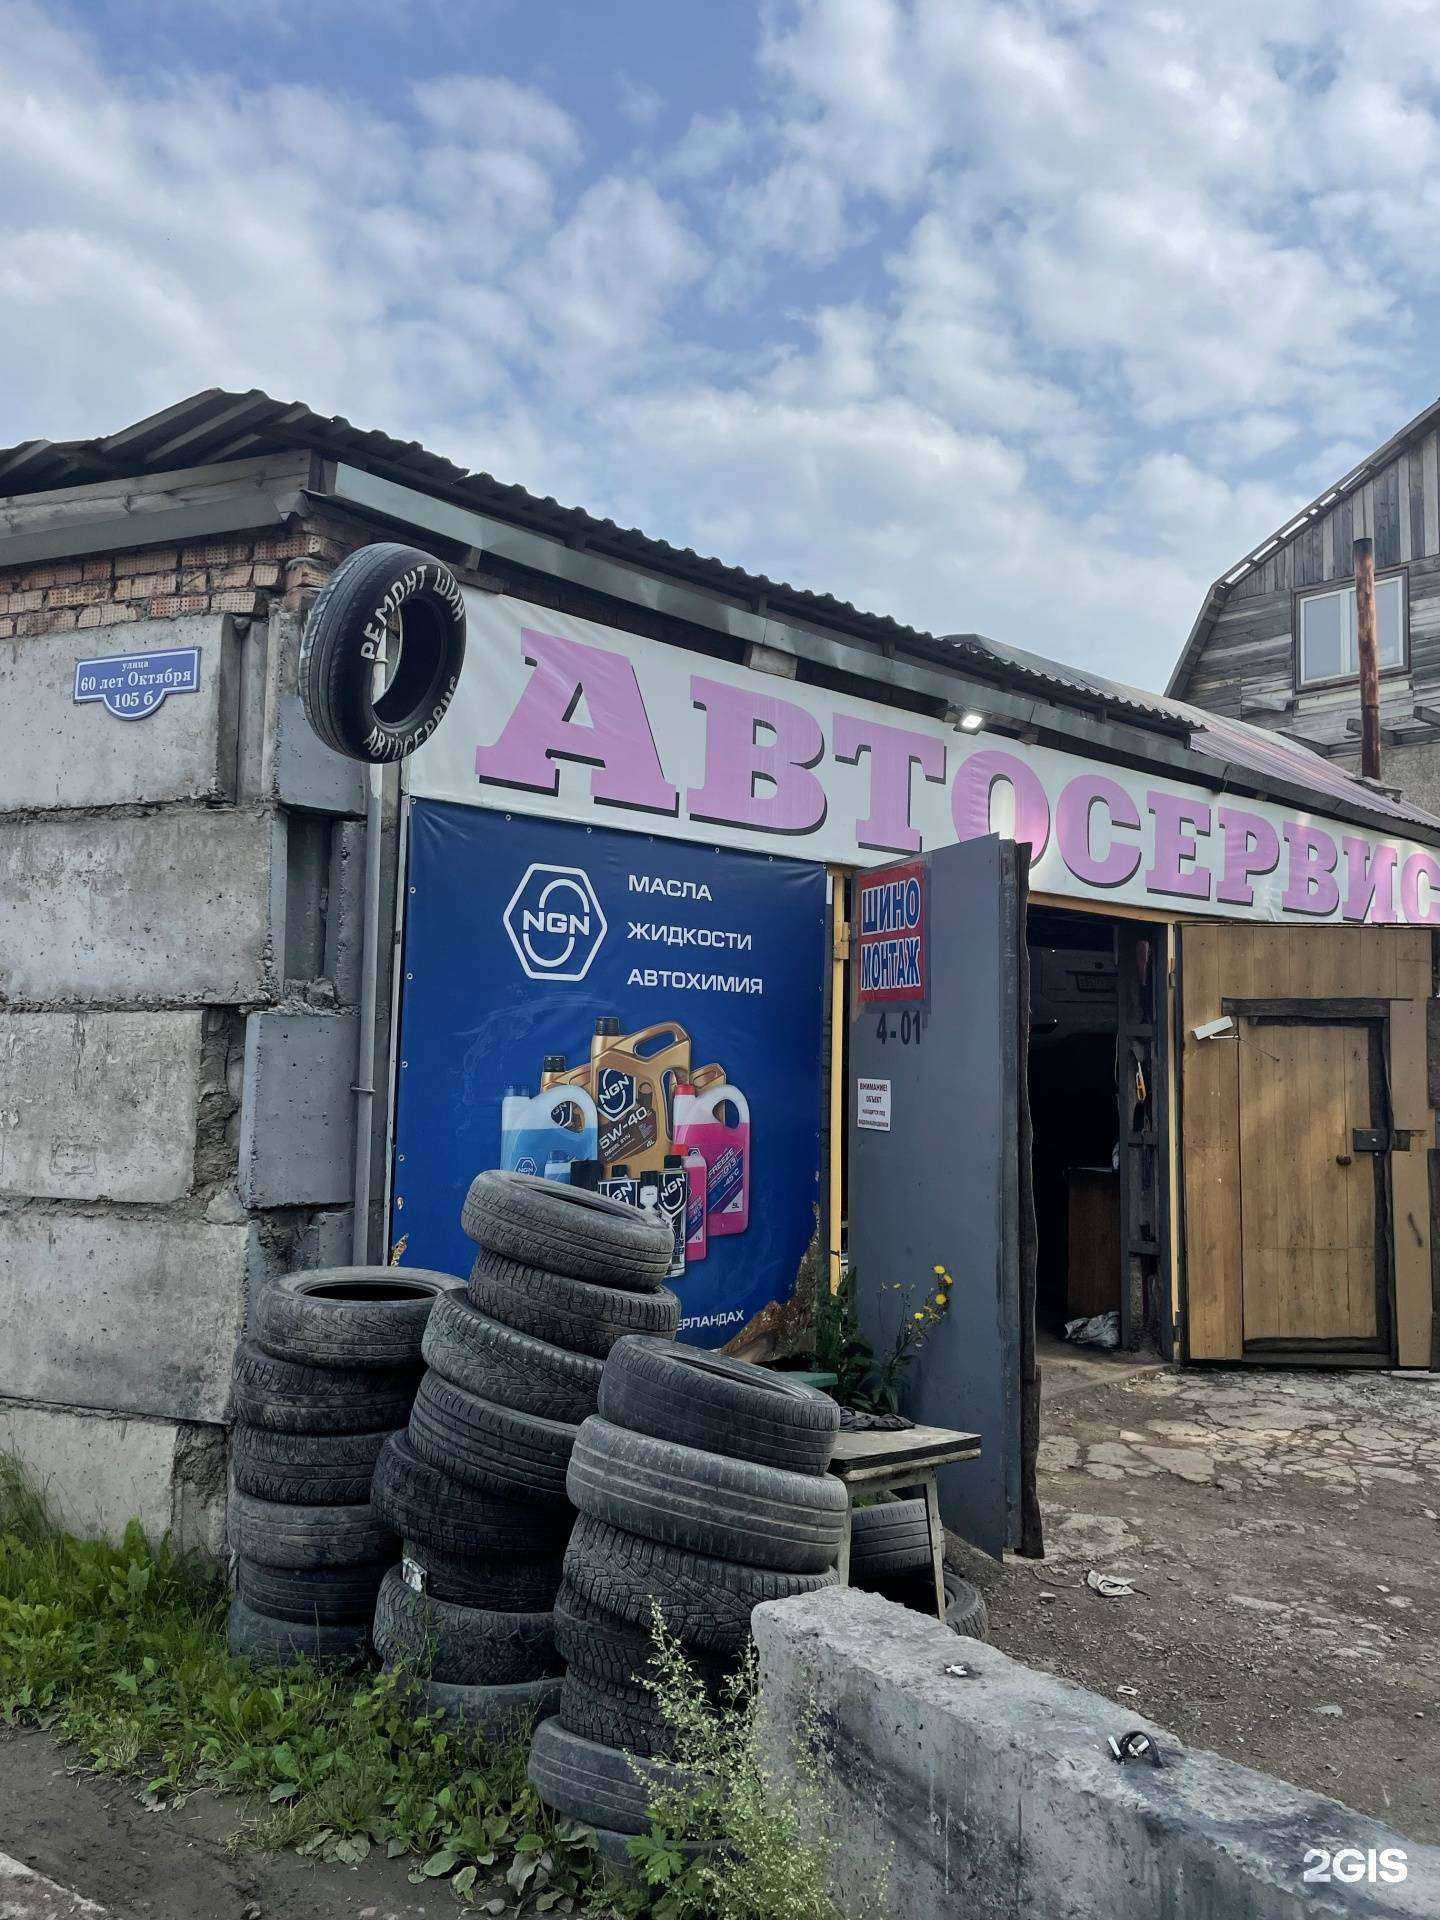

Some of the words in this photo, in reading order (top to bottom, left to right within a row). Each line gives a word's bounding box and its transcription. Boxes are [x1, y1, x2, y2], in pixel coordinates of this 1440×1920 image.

[361, 565, 427, 660] РЕМОНТ
[433, 568, 465, 622] ШИН
[81, 677, 96, 691] 60
[99, 677, 123, 689] лет
[127, 667, 192, 686] Октября
[121, 660, 149, 671] улица
[114, 691, 139, 707] 105
[363, 676, 457, 759] АВТОСЕРВИС
[475, 627, 1440, 925] АВТОСЕРВИС
[628, 874, 713, 902] МАСЛА
[861, 877, 921, 936] ШИНО
[523, 909, 590, 936] NGN
[627, 921, 752, 951] ЖИДКОСТИ
[861, 936, 921, 990] МОНТАЖ
[627, 968, 763, 995] АВТОХИМИЯ
[599, 1075, 630, 1105] NGN
[599, 1106, 647, 1149] 5W-40
[661, 1176, 686, 1200] NGN
